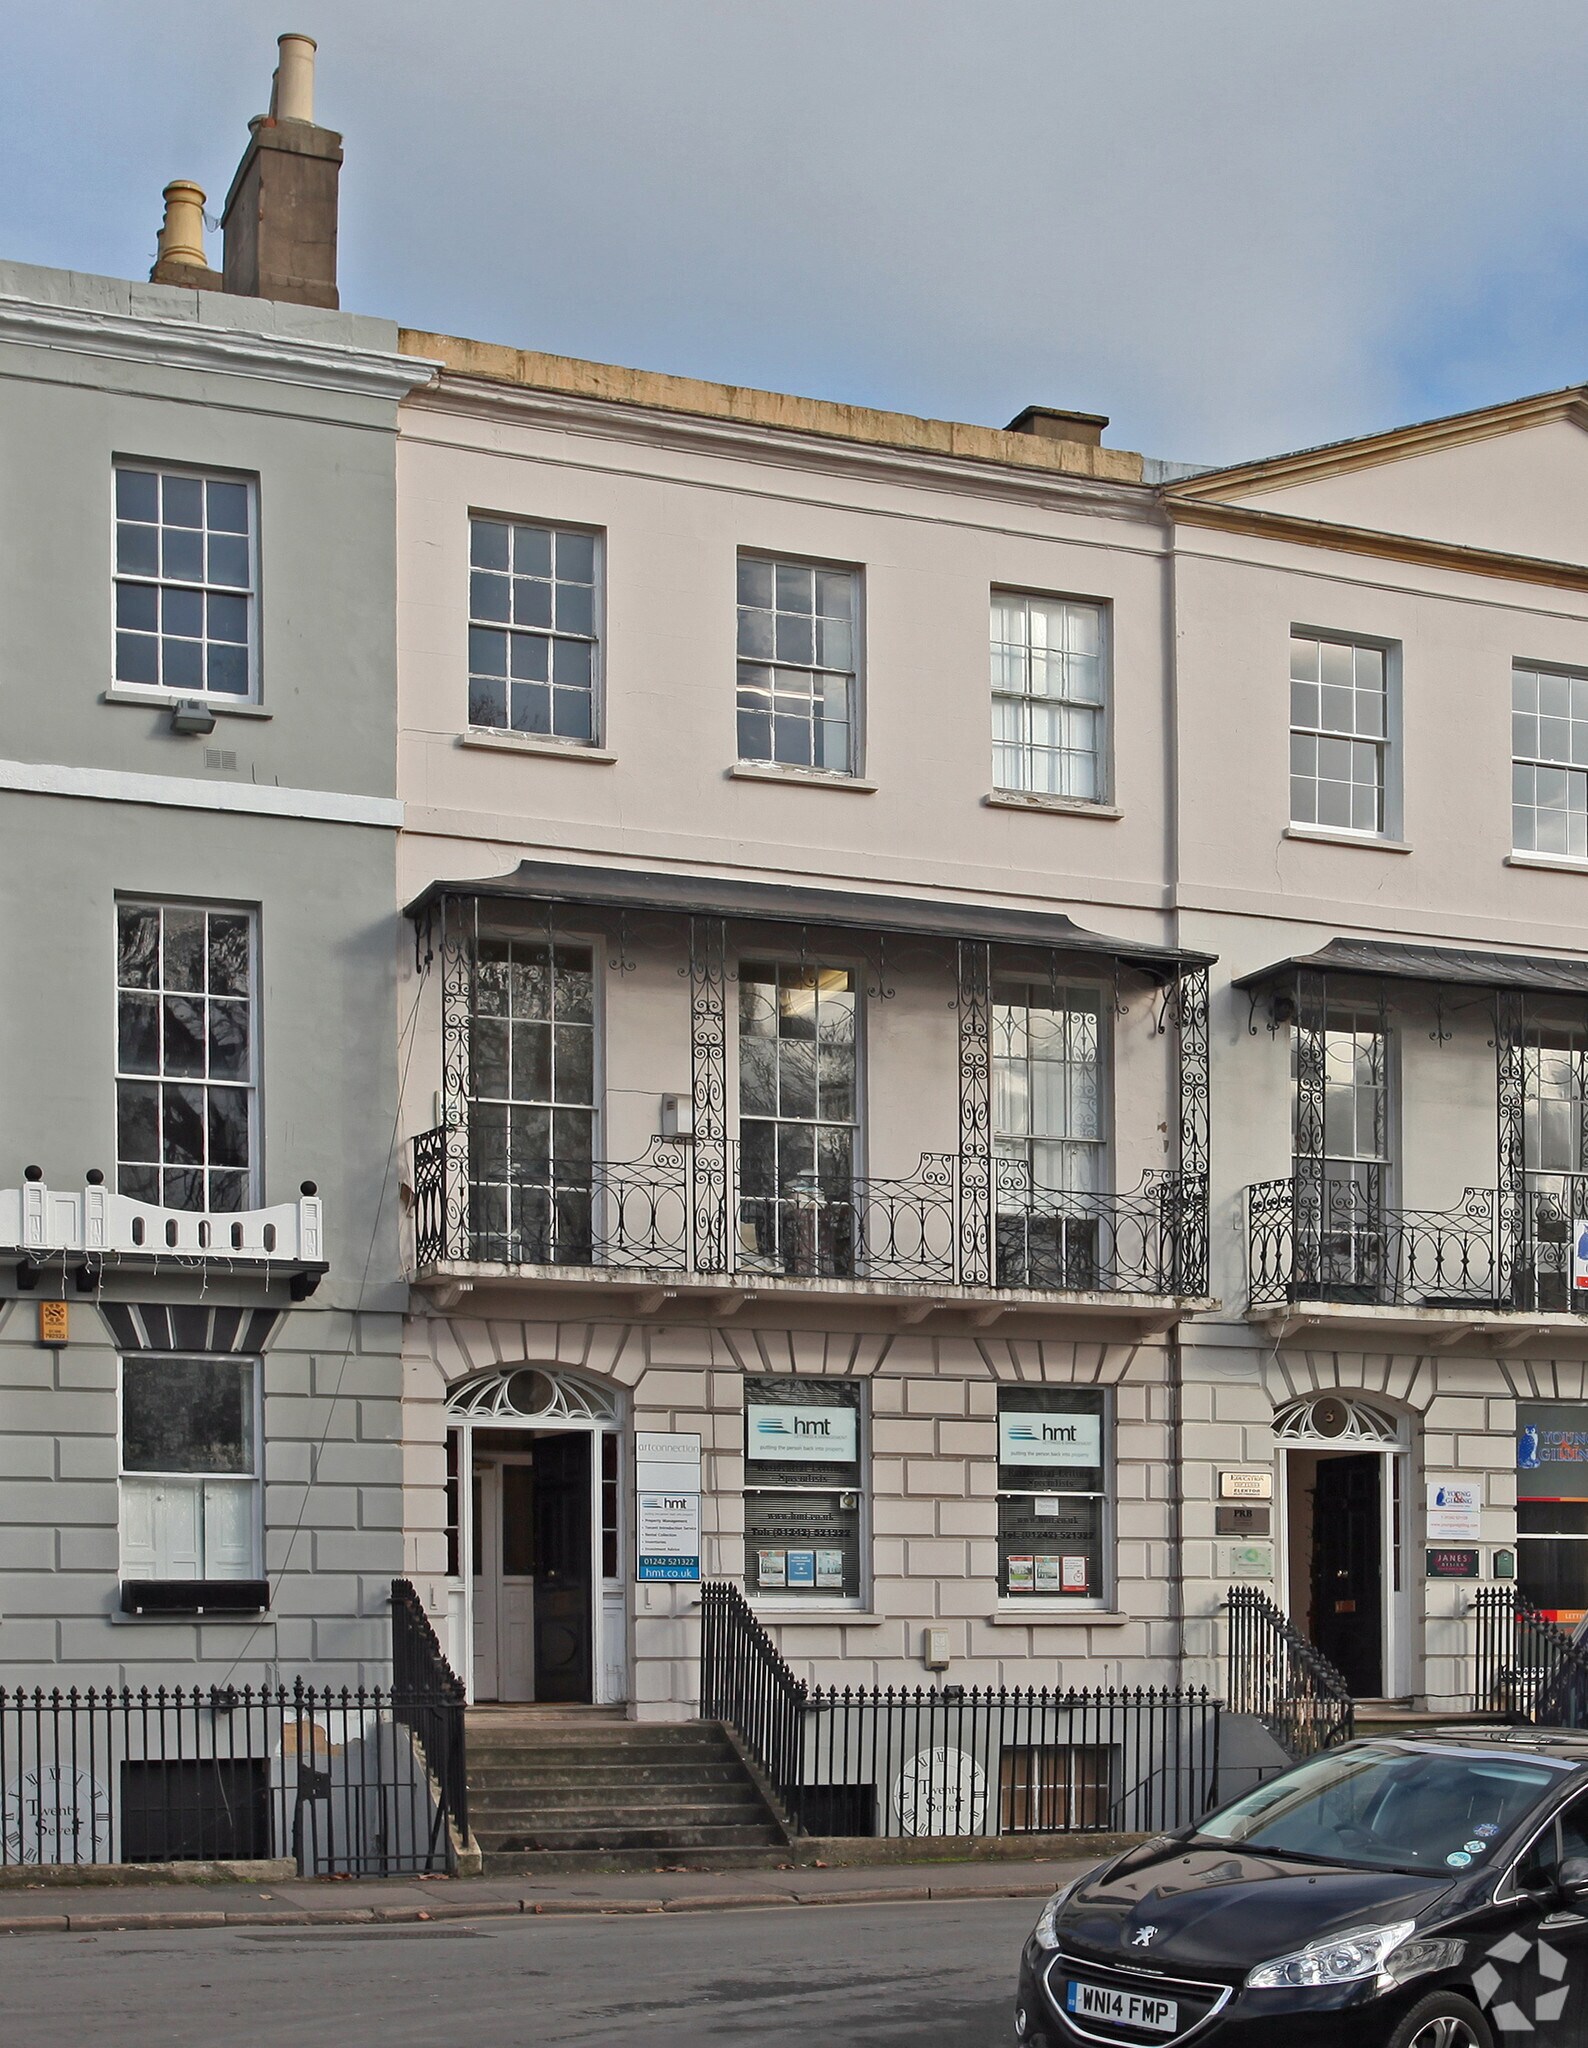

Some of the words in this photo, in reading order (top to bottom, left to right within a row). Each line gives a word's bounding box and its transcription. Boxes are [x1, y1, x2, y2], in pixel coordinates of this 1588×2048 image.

[794, 1416, 831, 1435] hmt
[1043, 1423, 1077, 1441] hmt
[1541, 1431, 1588, 1445] YOUN
[638, 1442, 699, 1453] artconnection
[1540, 1448, 1588, 1462] GILLIN
[664, 1497, 687, 1509] hmt
[1234, 1509, 1253, 1517] PRB
[643, 1557, 666, 1566] 01242
[668, 1558, 695, 1566] 521322
[1437, 1554, 1468, 1563] JANES
[645, 1567, 693, 1578] hmt.co.uk
[1564, 1612, 1585, 1620] LETTI
[1083, 1987, 1123, 2017] WN14
[1128, 1997, 1169, 2024] FMP
